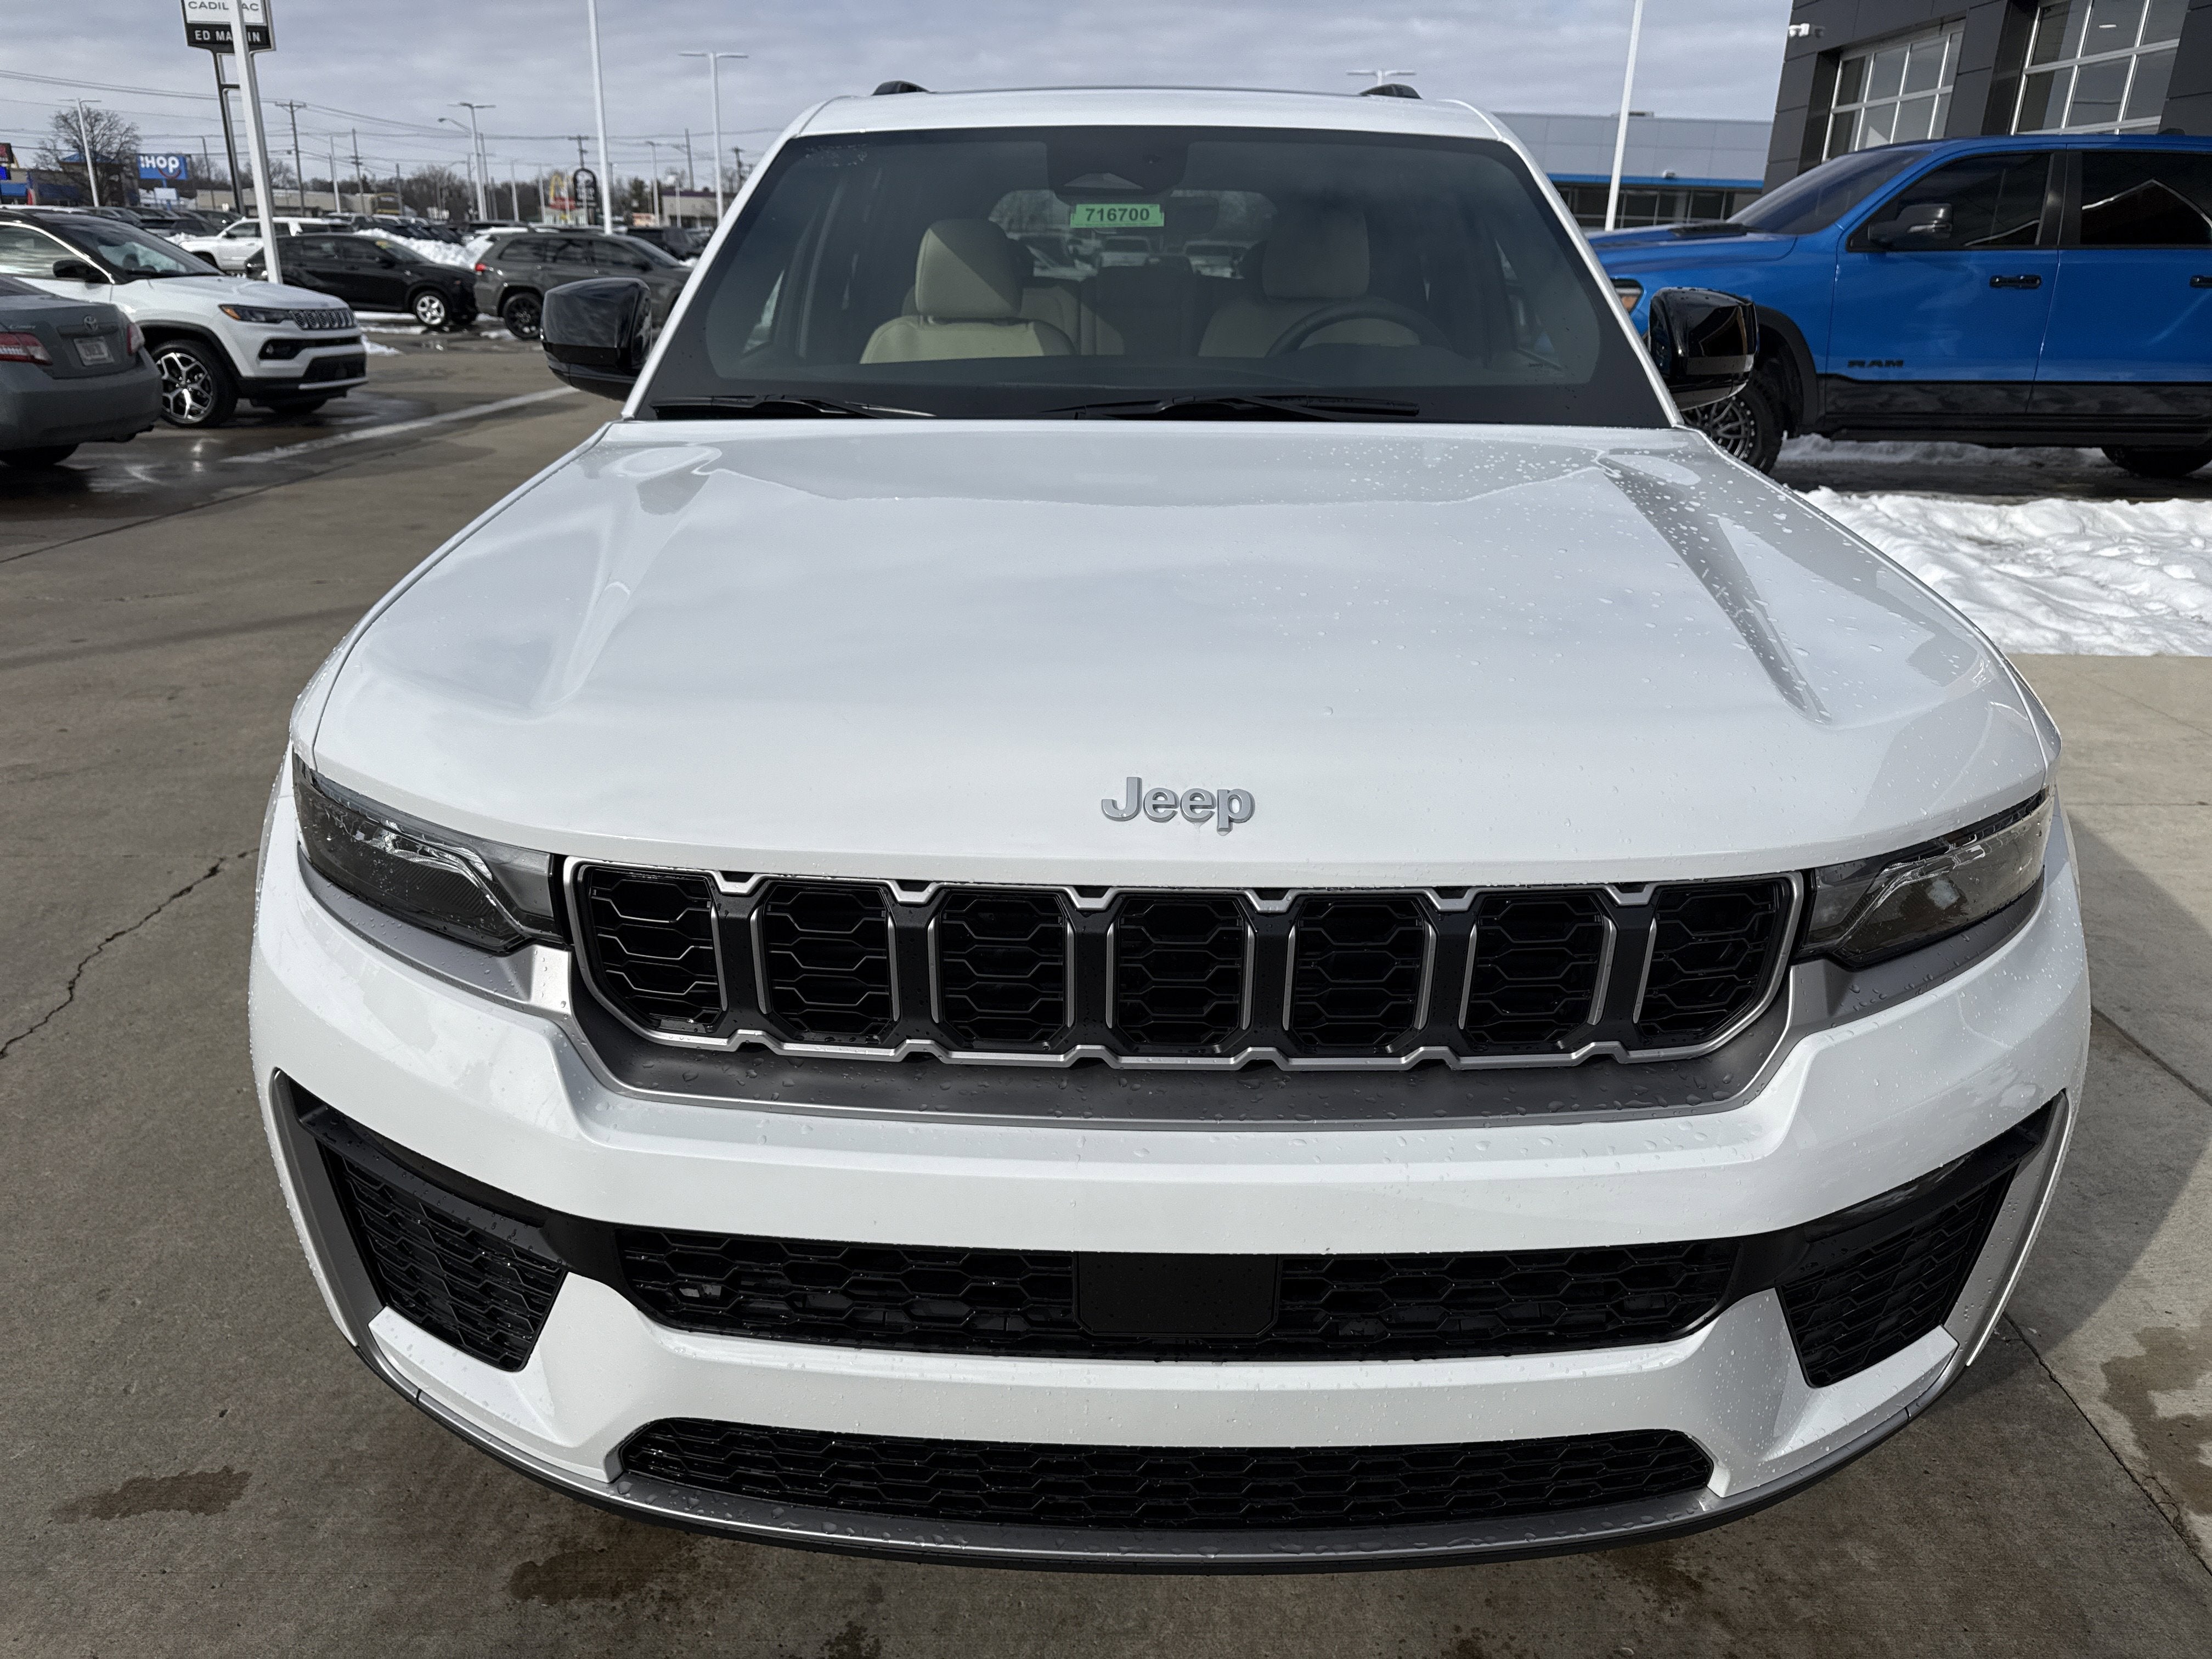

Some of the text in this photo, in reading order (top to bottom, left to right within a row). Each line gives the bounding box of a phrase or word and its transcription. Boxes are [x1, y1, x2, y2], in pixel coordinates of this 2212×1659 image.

[188, 2, 259, 11] CADILAC
[195, 30, 261, 43] ED MAIN
[1085, 208, 1149, 221] 716700
[1848, 360, 1904, 368] RAM
[1101, 776, 1255, 832] Jeep
